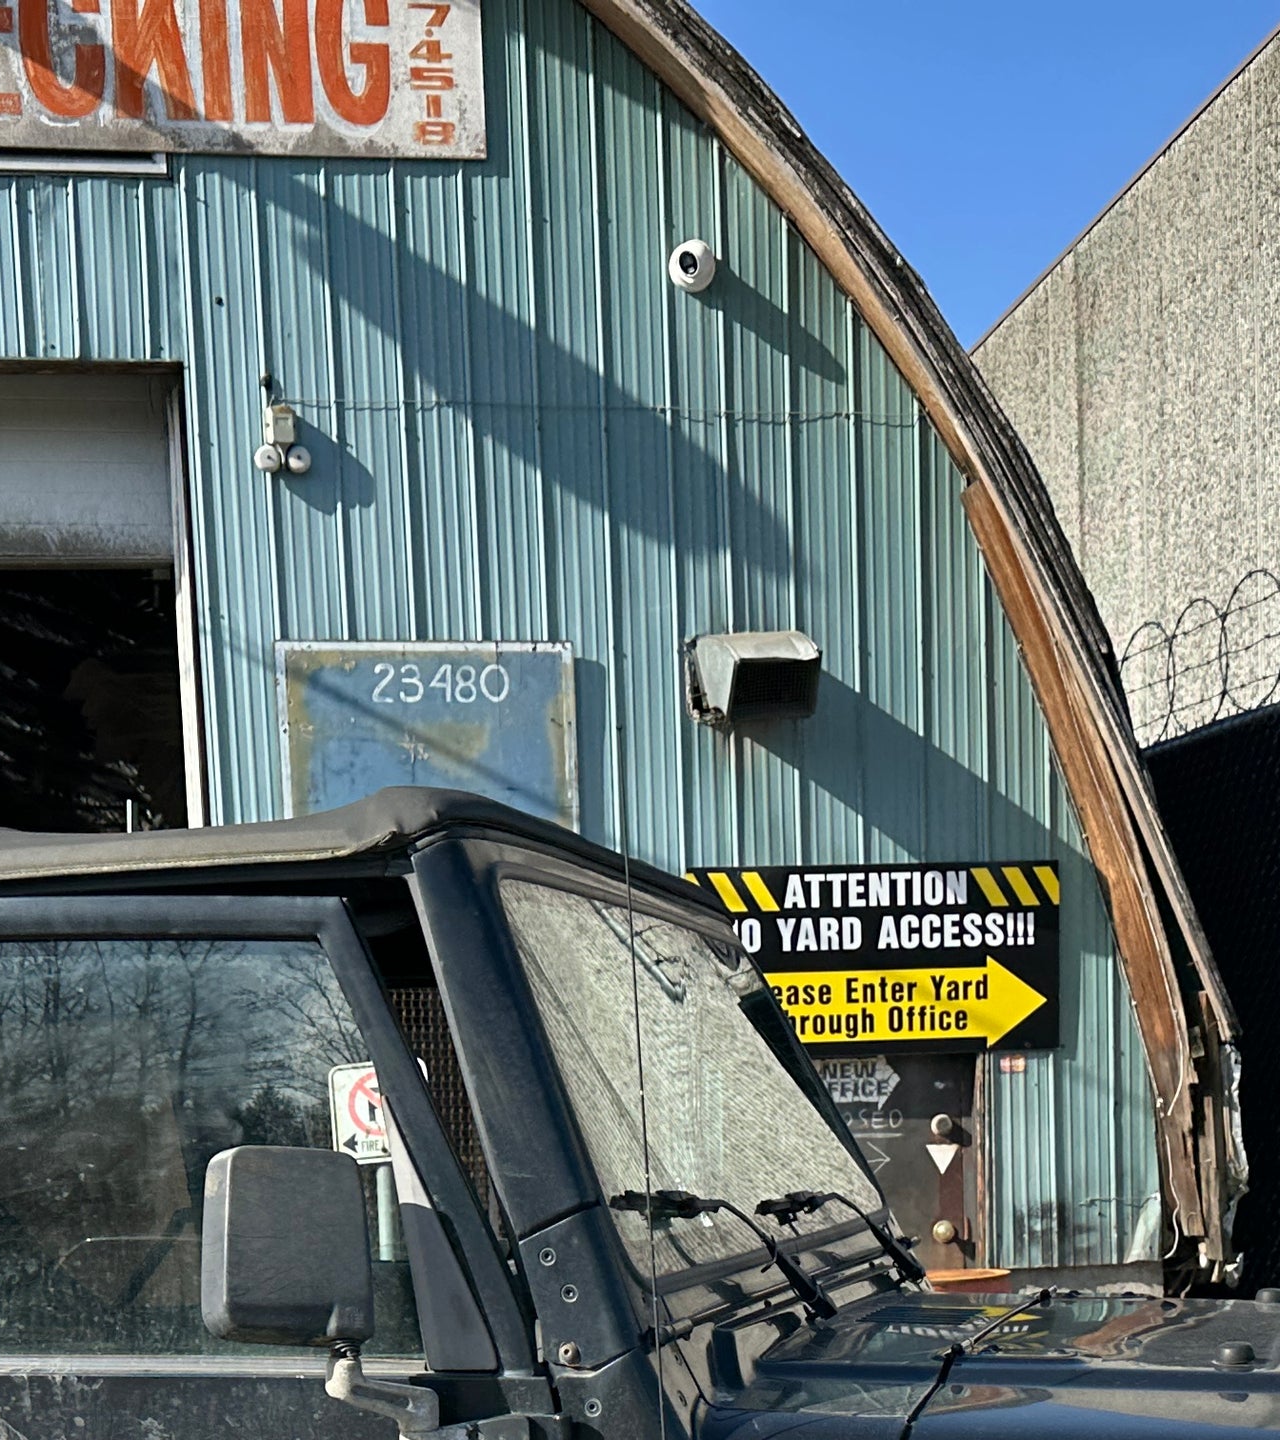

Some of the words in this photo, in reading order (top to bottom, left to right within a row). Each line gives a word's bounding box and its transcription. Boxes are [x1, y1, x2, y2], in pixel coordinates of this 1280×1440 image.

[371, 663, 510, 703] 23480
[783, 870, 969, 909] ATTENTION
[776, 916, 863, 952] YARD
[877, 911, 1036, 950] ACCESS!!!
[770, 983, 833, 1006] ease
[846, 976, 918, 1005] Enter
[930, 973, 989, 1001] Yard
[784, 1009, 875, 1038] hrough
[888, 1004, 969, 1033] Office
[827, 1080, 890, 1098] FFICE
